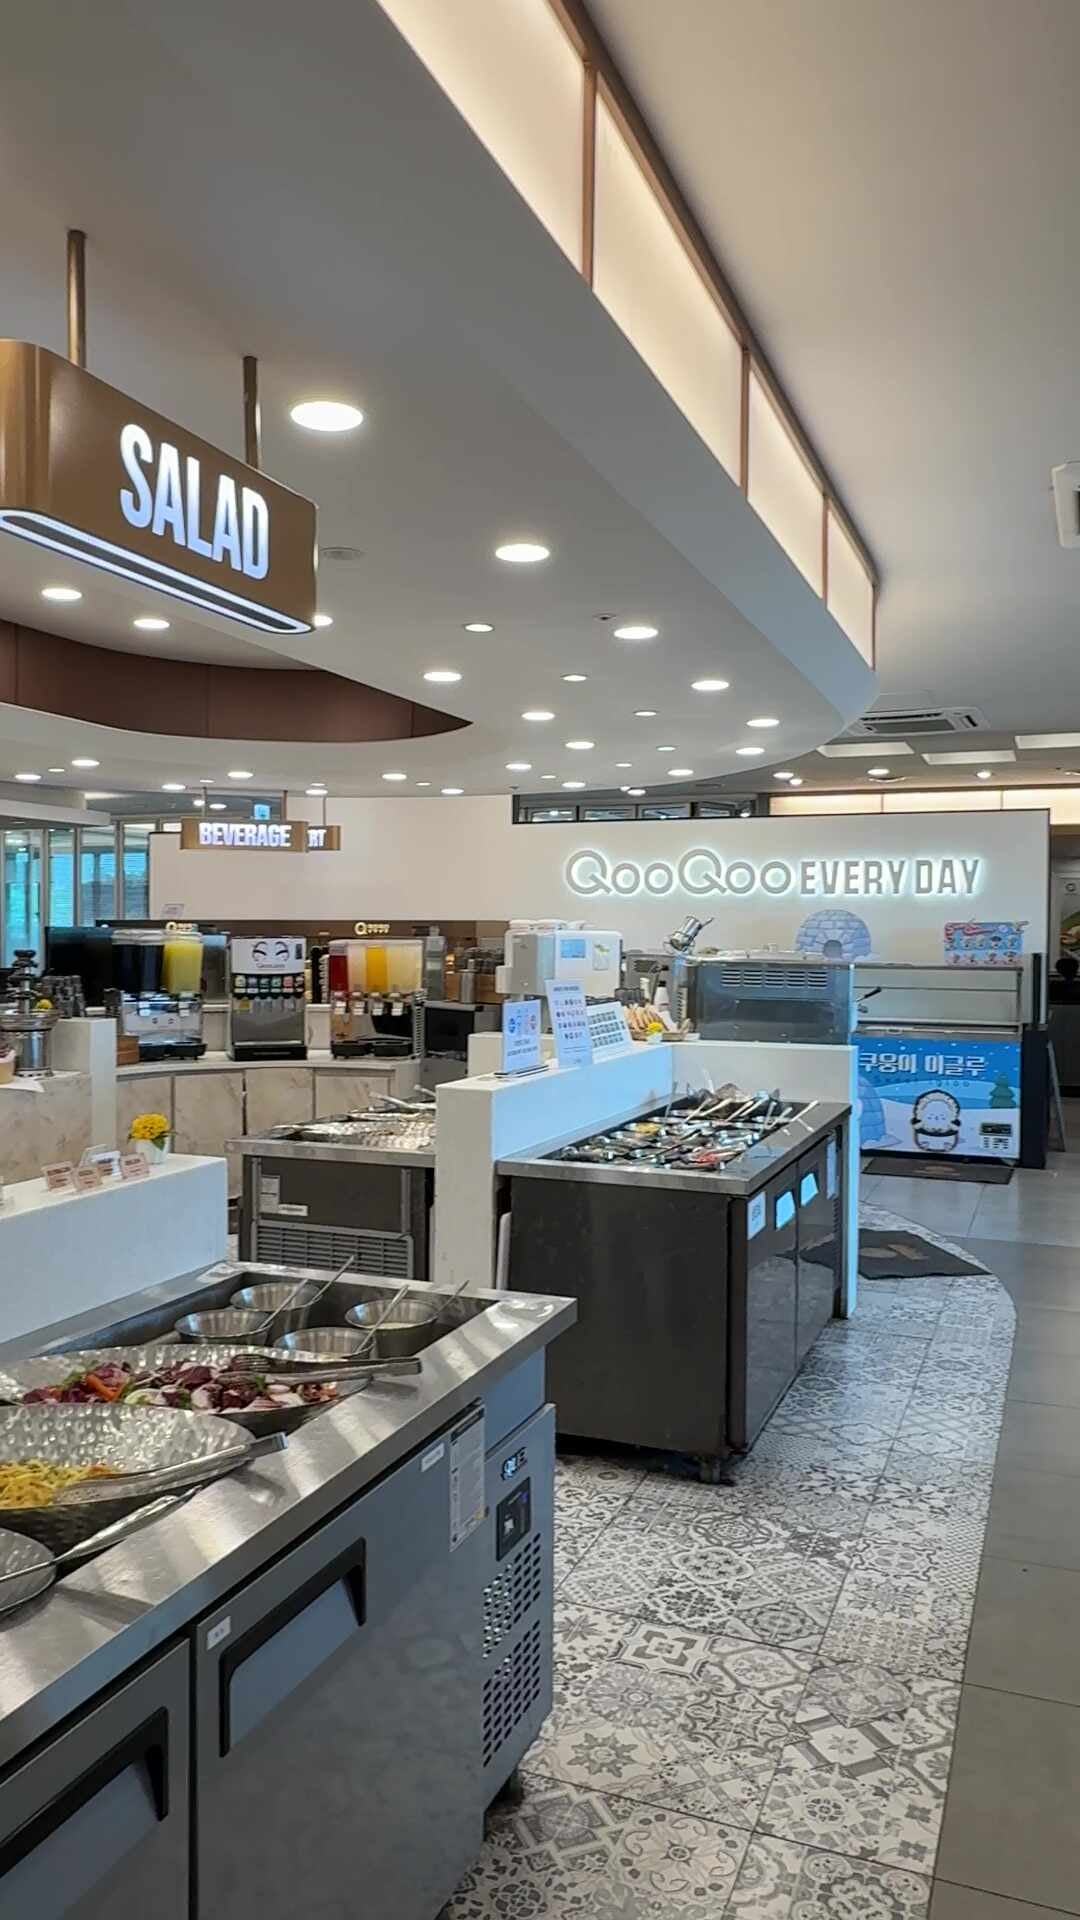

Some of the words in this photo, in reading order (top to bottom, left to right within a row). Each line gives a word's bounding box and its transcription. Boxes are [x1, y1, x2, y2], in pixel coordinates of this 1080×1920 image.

[120, 423, 269, 580] SALAD
[199, 823, 292, 847] BEVERAGE
[800, 860, 905, 895] EVERY
[915, 860, 980, 895] DAY
[860, 1052, 918, 1074] 쿠웅이
[924, 1054, 987, 1077] 이글루
